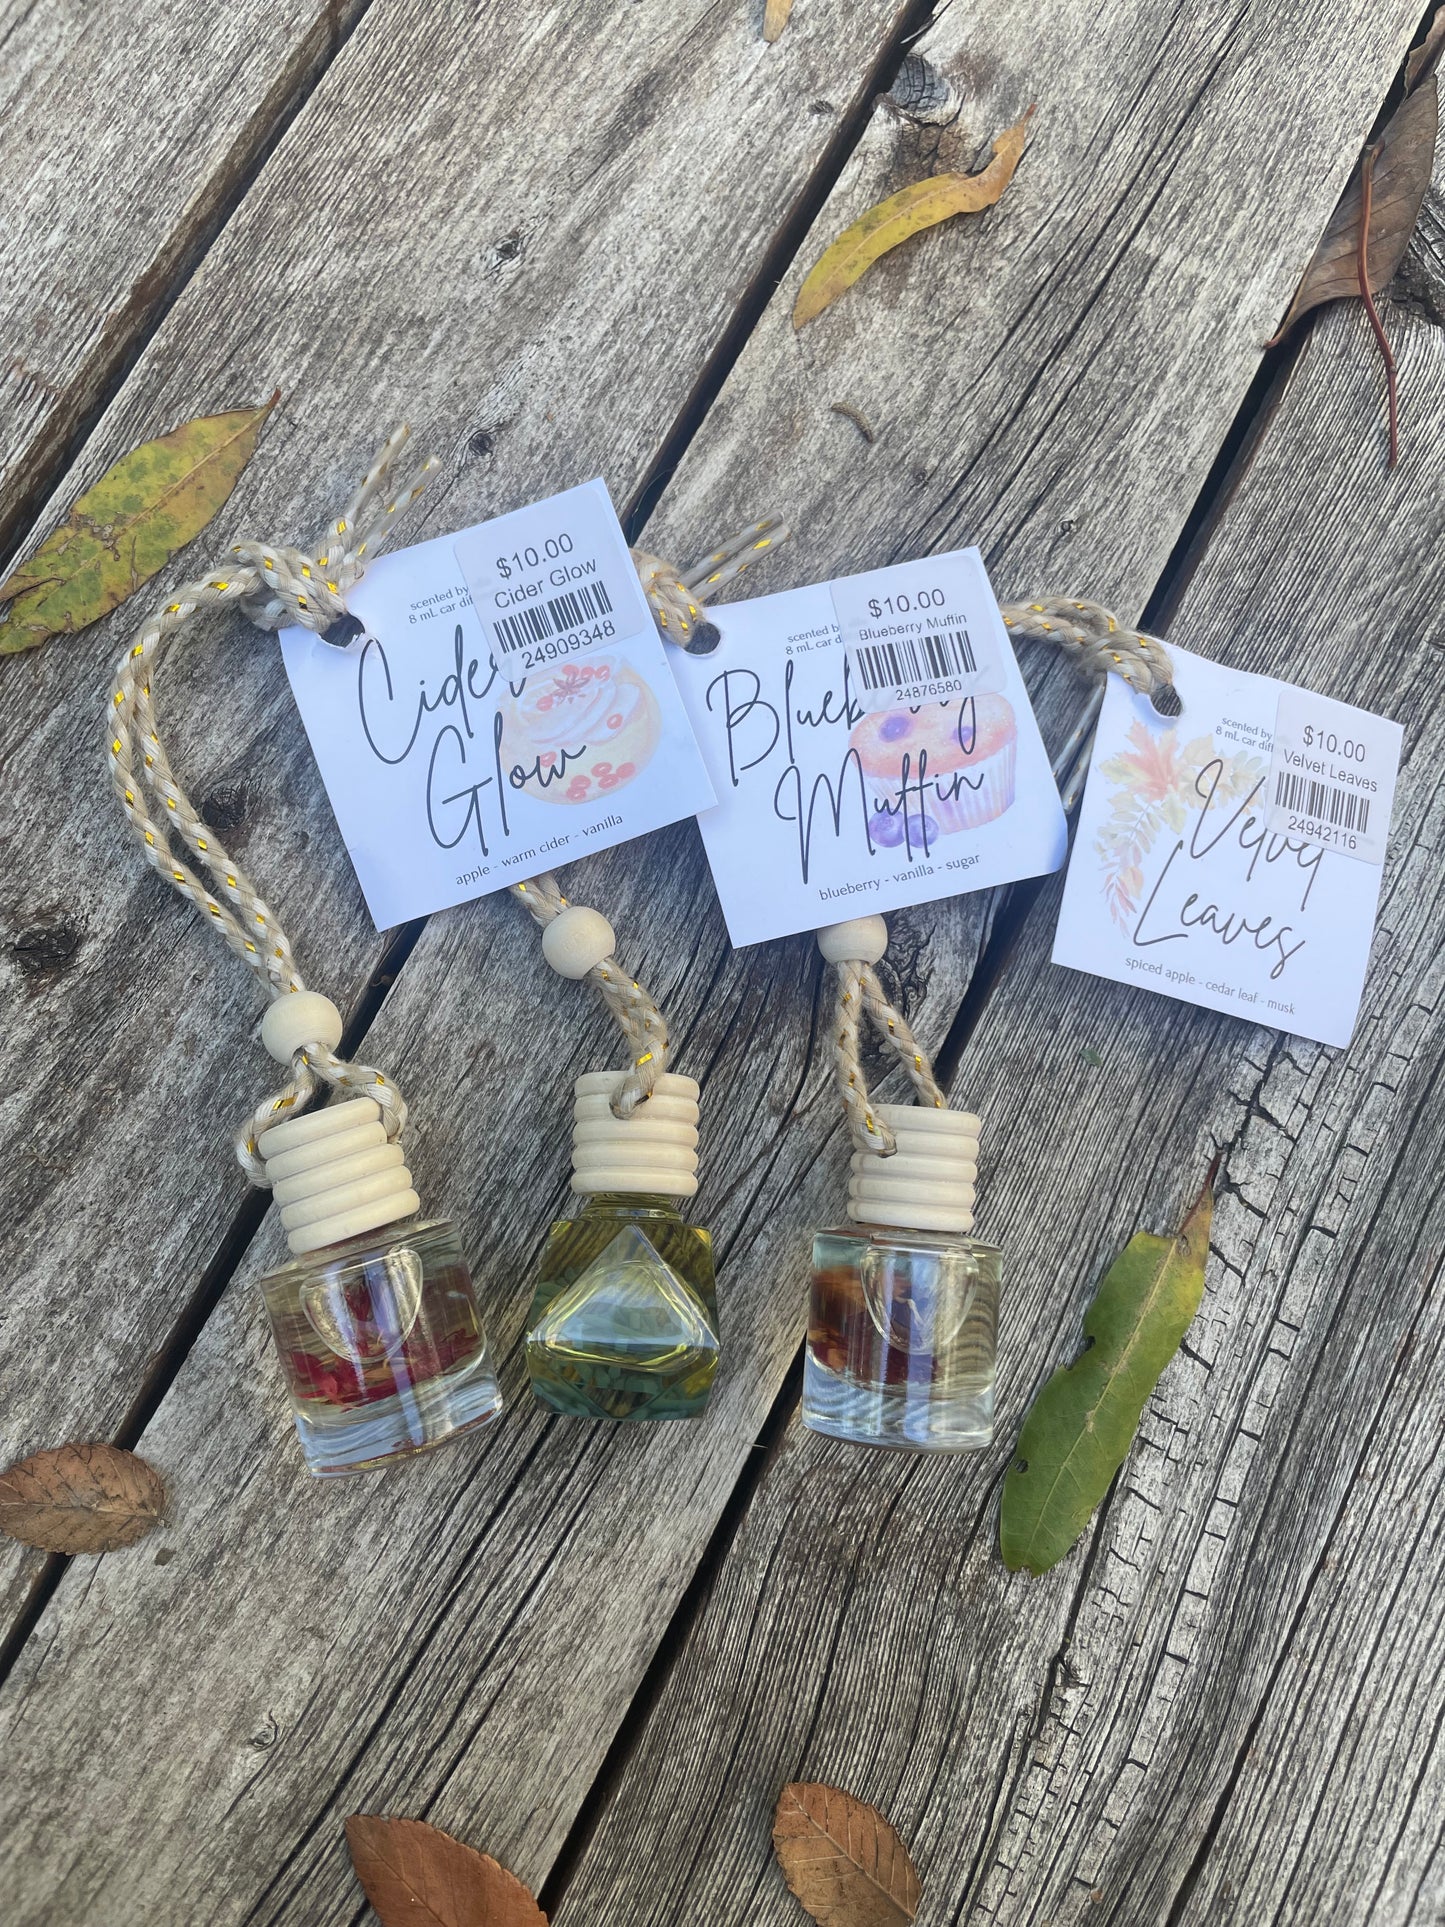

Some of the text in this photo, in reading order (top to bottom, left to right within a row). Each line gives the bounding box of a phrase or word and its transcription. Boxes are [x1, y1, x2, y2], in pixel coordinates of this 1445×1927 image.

[496, 533, 573, 580] $10.00
[410, 586, 469, 611] scented by
[494, 559, 597, 608] Cider Glow
[408, 614, 417, 624] 8
[420, 608, 438, 621] mL
[440, 603, 456, 614] car
[868, 588, 945, 619] $10.00
[521, 619, 616, 669] 24909348
[787, 625, 829, 643] scented
[859, 622, 922, 641] Blueberry
[926, 613, 967, 629] Muffin
[785, 646, 793, 655] 8
[796, 641, 814, 653] mL
[815, 639, 832, 648] car
[895, 679, 962, 701] 24876580
[1215, 725, 1222, 735] 8
[1224, 730, 1240, 742] mL
[1242, 737, 1256, 747] car
[1221, 717, 1273, 743] scented by
[1303, 725, 1365, 762] $10.00
[426, 711, 587, 857] Glow
[1284, 748, 1378, 792] Velvet Leaves
[774, 748, 984, 885] Muffin
[1288, 815, 1357, 849] 24942116
[456, 866, 490, 885] apple
[501, 849, 536, 867] warm
[539, 835, 570, 853] cider
[582, 814, 623, 836] vanilla
[819, 879, 881, 901] blueberry
[892, 865, 934, 883] vanilla
[945, 854, 980, 870] sugar
[1133, 840, 1306, 980] Leaves
[1125, 957, 1163, 975] spiced
[1165, 968, 1196, 985] apple
[1205, 980, 1235, 997] cedar
[1238, 988, 1258, 1003] leaf
[1267, 999, 1296, 1015] musk
